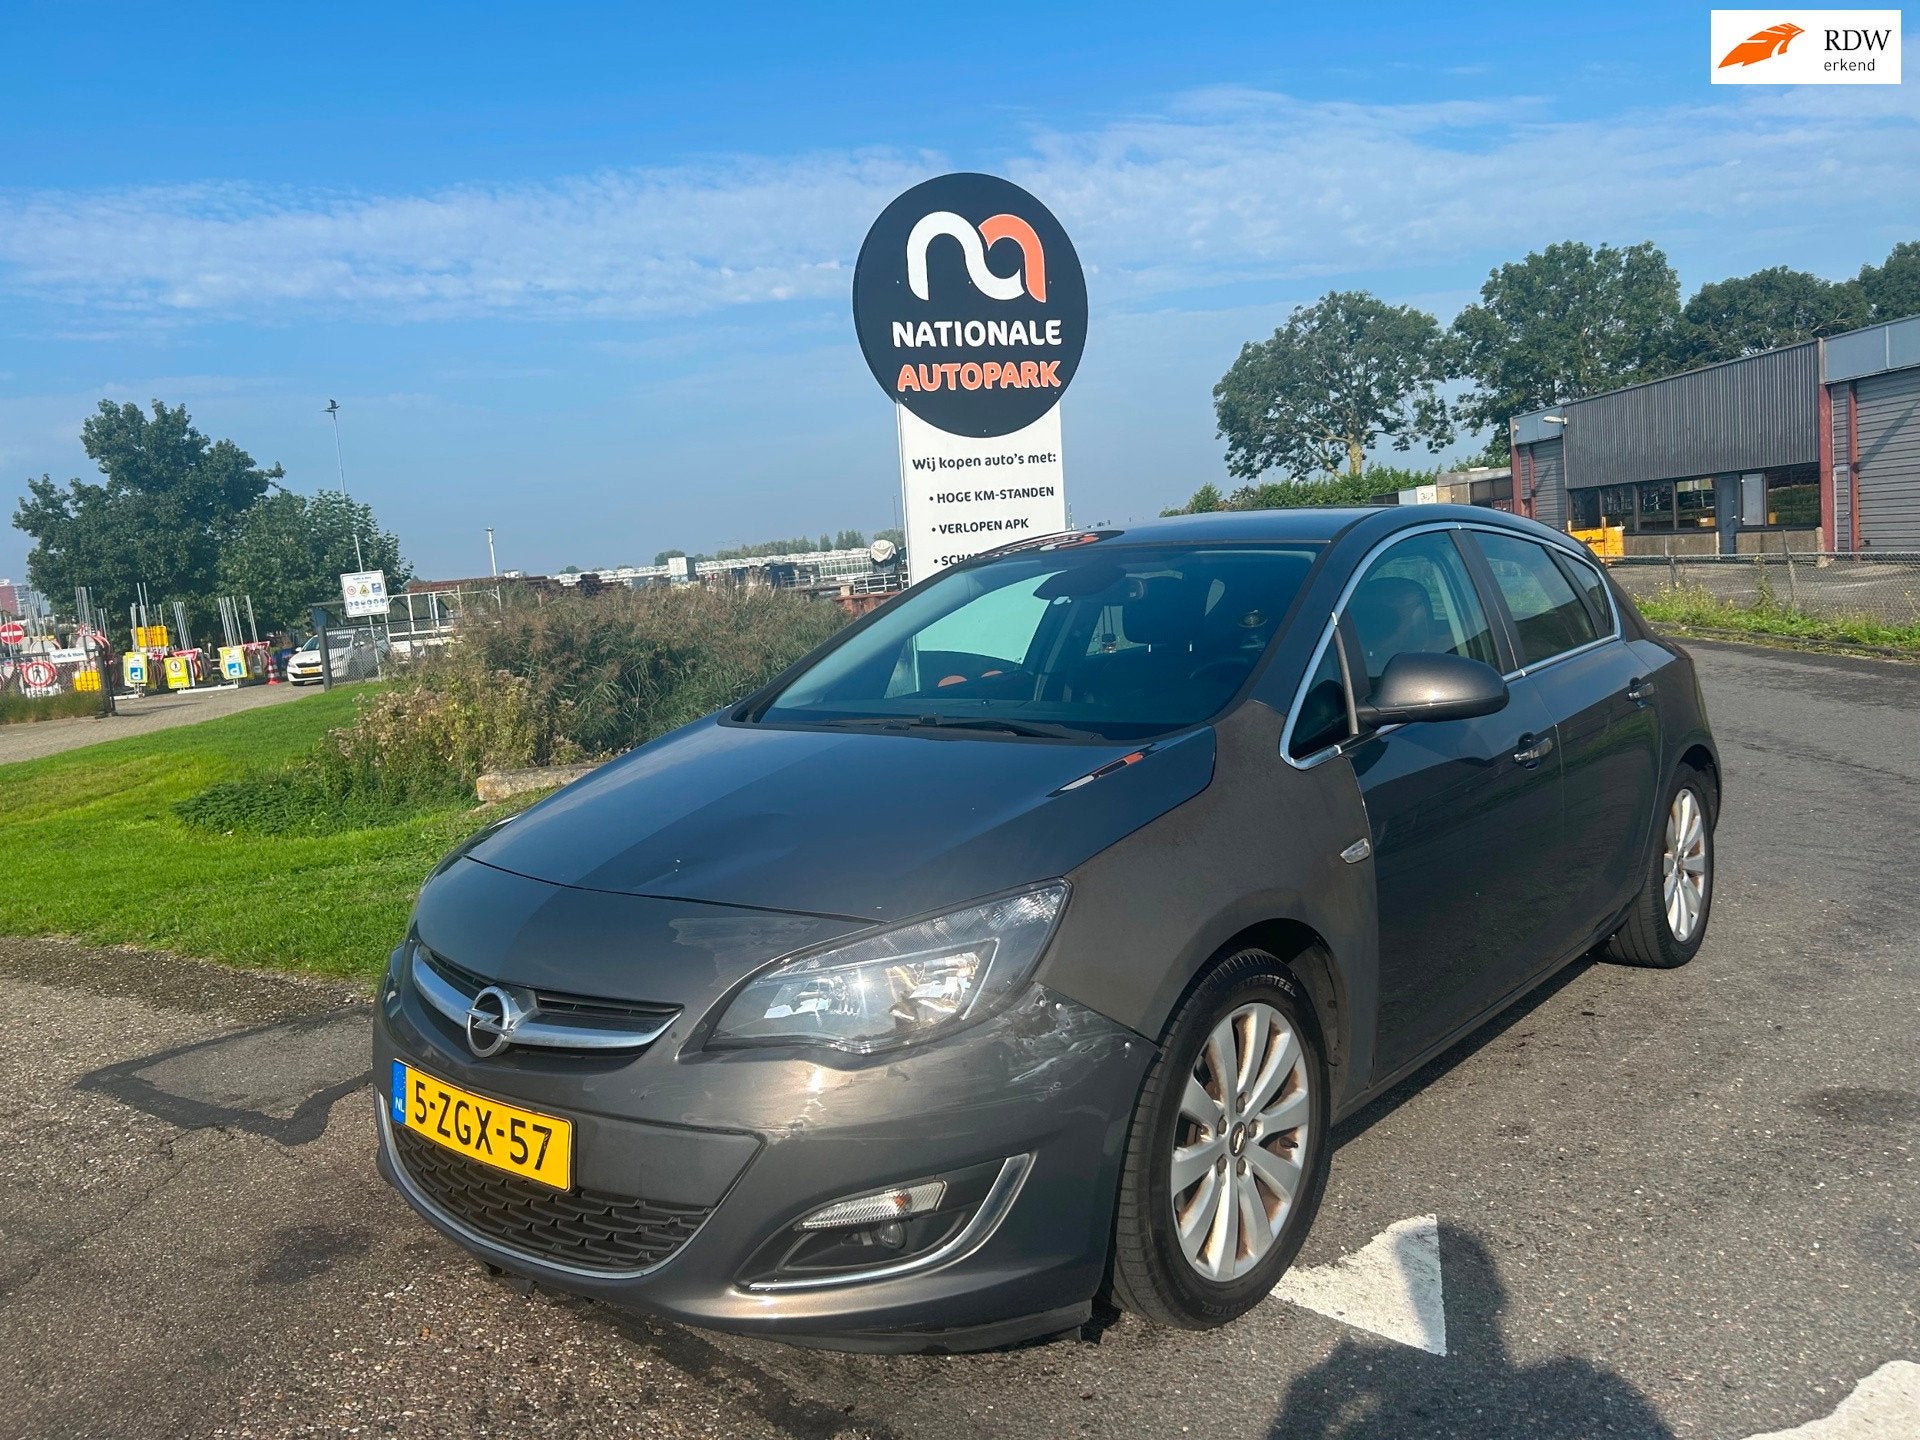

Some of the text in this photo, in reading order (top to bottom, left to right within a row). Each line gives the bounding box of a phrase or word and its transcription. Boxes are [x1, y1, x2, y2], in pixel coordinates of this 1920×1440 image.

[892, 319, 1062, 348] NATIONALE
[897, 360, 1062, 392] AUTOPARK
[912, 452, 1057, 472] Wij kopen auto's met:
[936, 486, 1055, 504] HOGE KM-STANDEN
[939, 518, 1029, 535] VERLOPEN APK
[395, 1096, 405, 1113] NL
[414, 1080, 552, 1171] 5-ZGX-57
